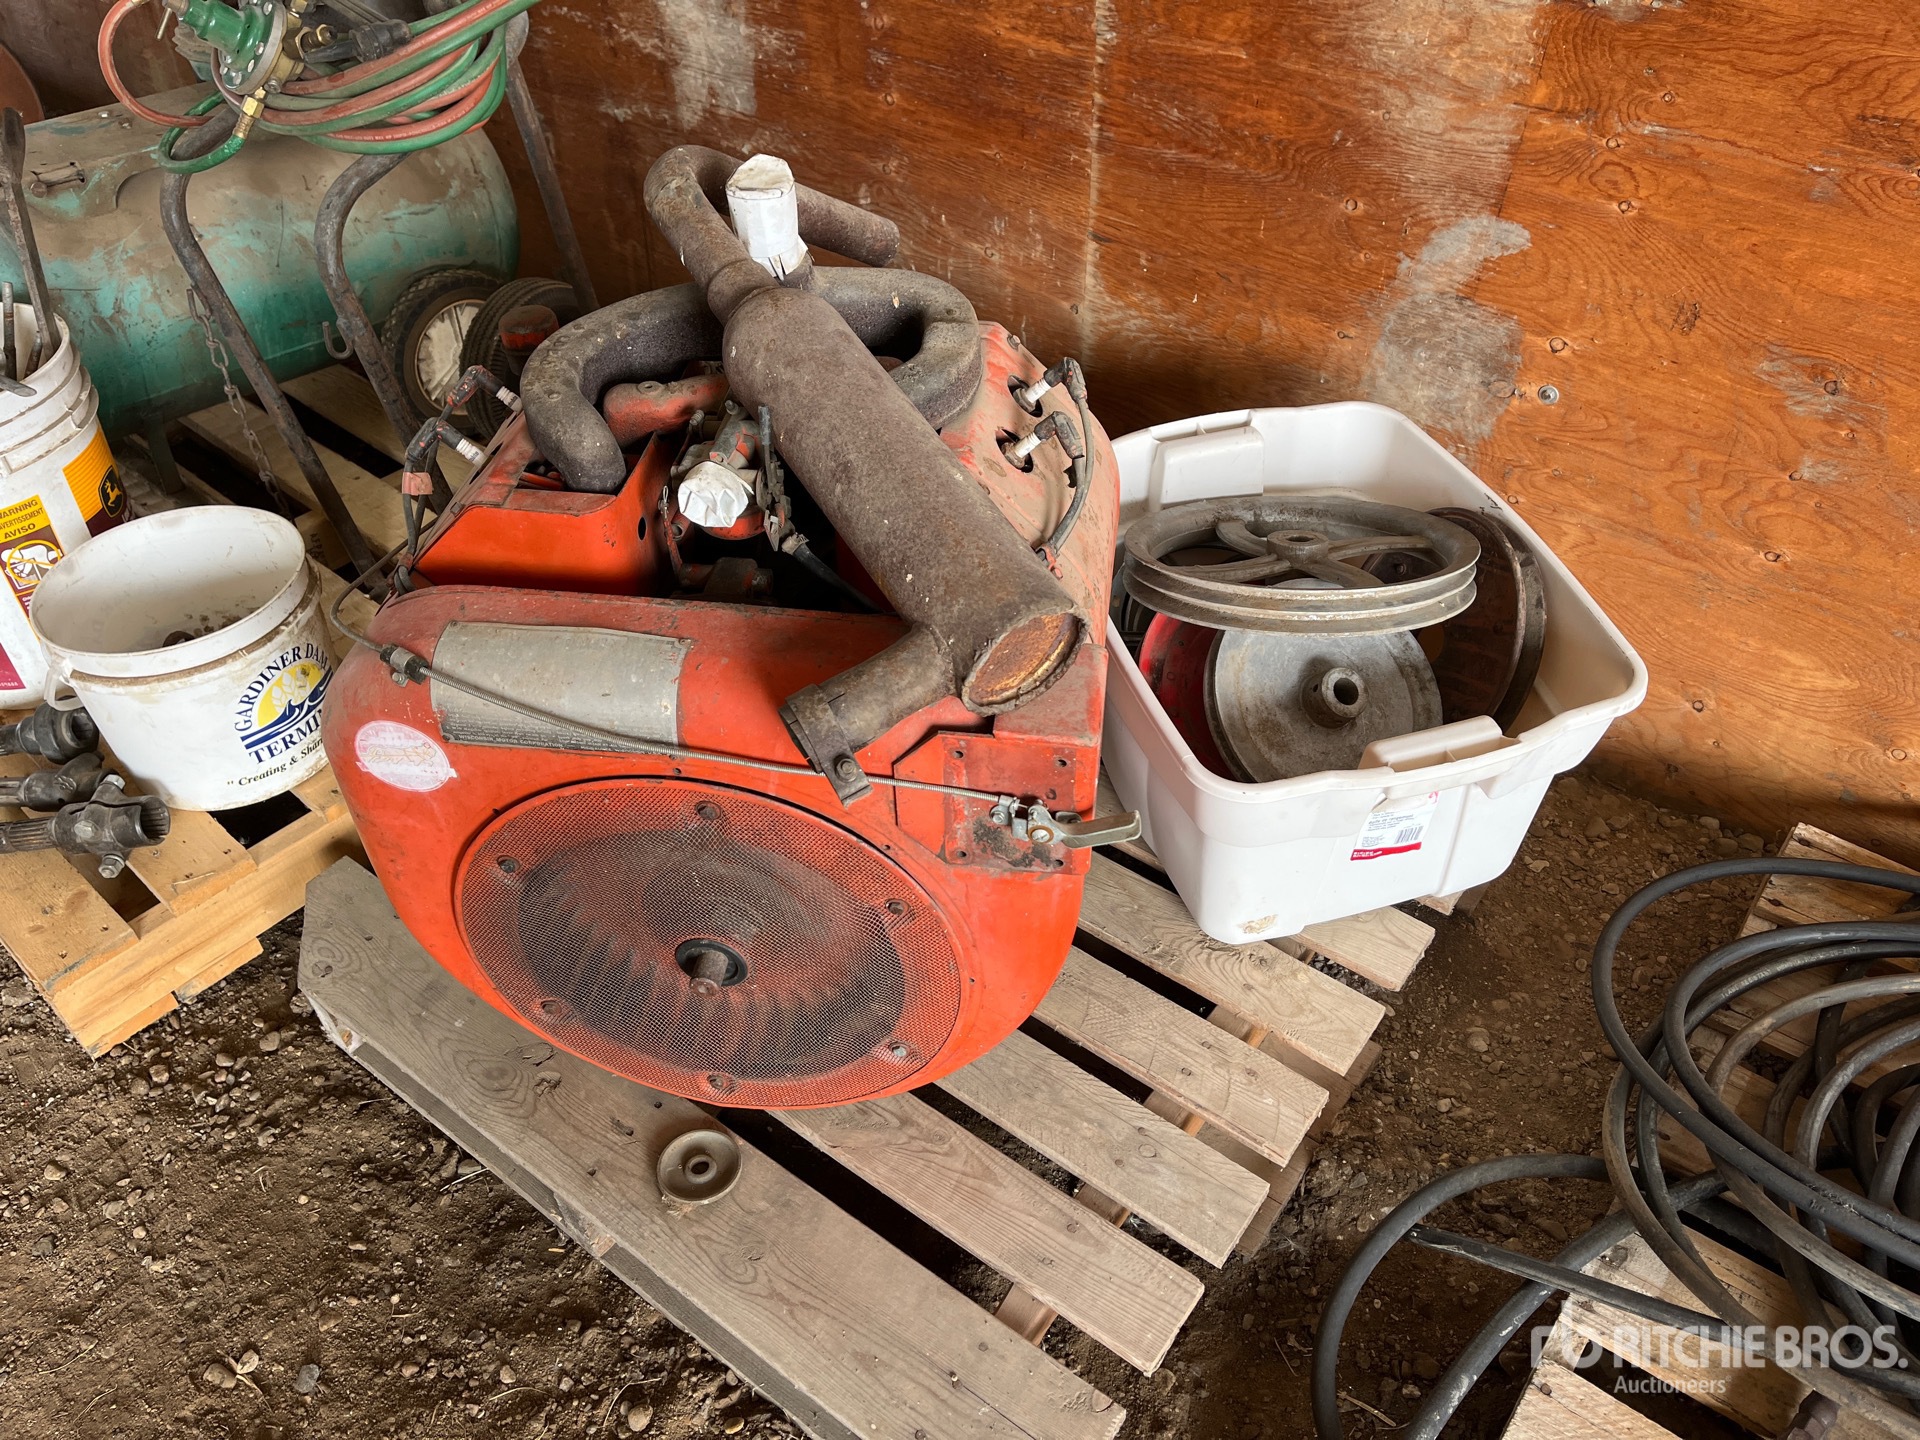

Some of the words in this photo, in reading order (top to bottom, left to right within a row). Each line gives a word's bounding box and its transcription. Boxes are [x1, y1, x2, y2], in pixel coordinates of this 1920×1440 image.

[4, 522, 36, 539] AVISO
[234, 646, 302, 732] GARDINER
[305, 643, 327, 670] DAM
[238, 763, 287, 786] Creating
[289, 755, 298, 766] &
